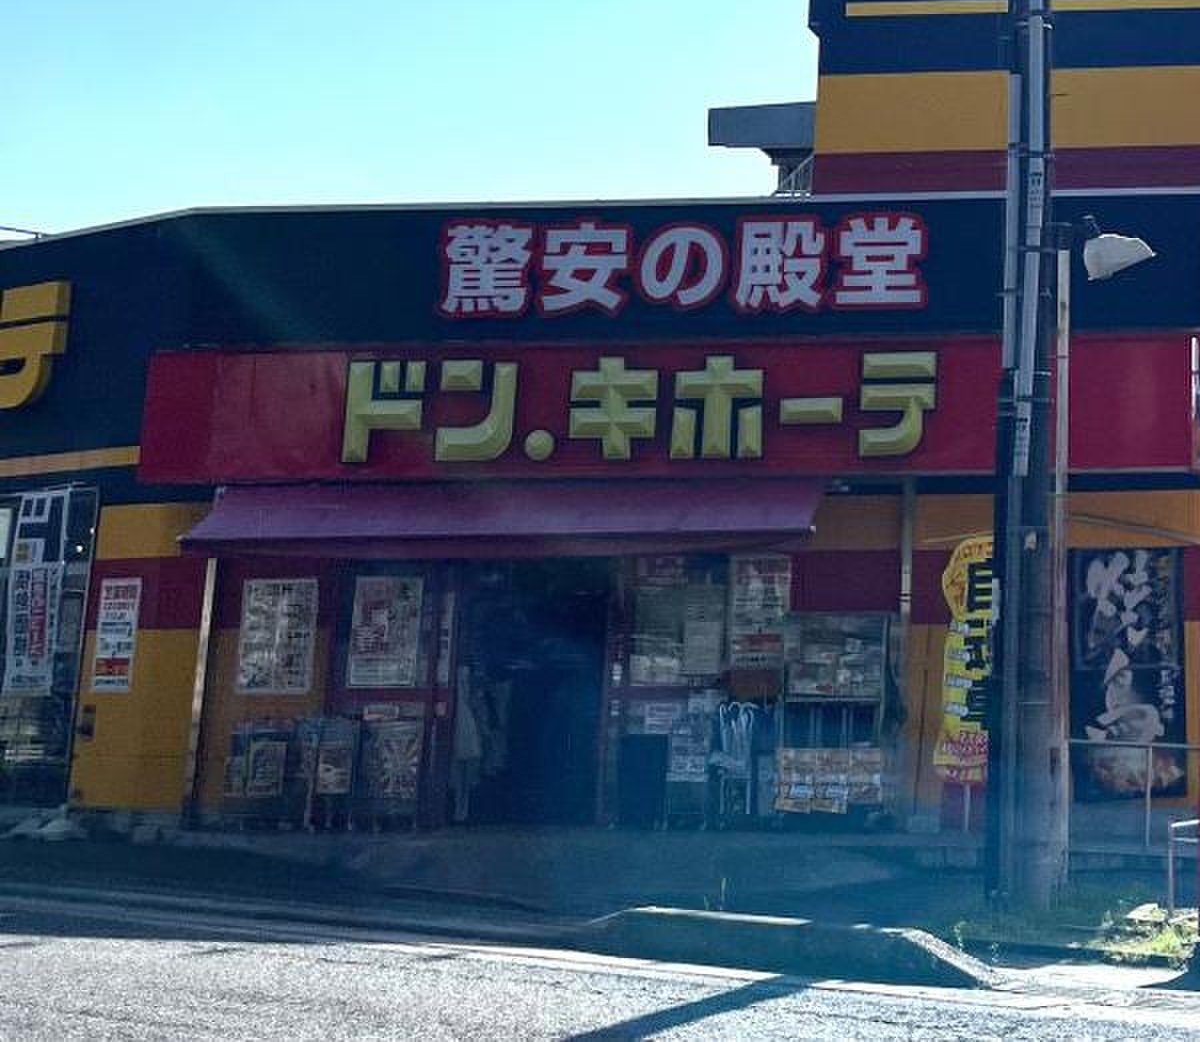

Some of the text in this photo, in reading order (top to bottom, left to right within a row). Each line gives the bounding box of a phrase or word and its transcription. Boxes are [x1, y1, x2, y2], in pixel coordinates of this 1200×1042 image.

[438, 214, 927, 317] 驚安の殿堂
